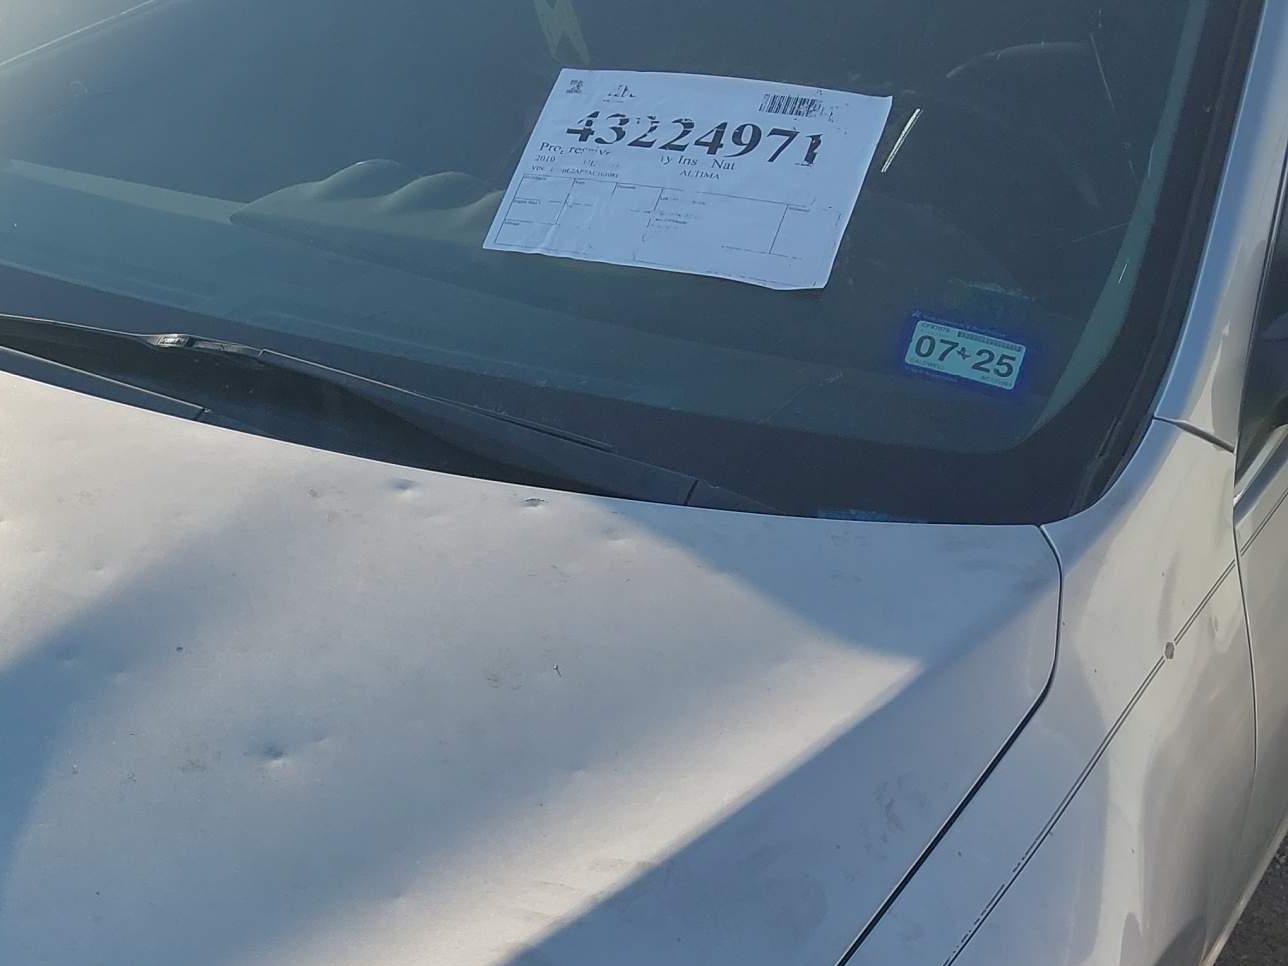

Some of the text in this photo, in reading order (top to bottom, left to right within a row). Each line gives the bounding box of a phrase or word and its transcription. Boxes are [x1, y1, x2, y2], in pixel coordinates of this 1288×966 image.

[566, 111, 823, 166] 43224971
[679, 169, 720, 180] ALTIMA
[915, 335, 959, 361] 07
[972, 349, 1016, 378] 25
